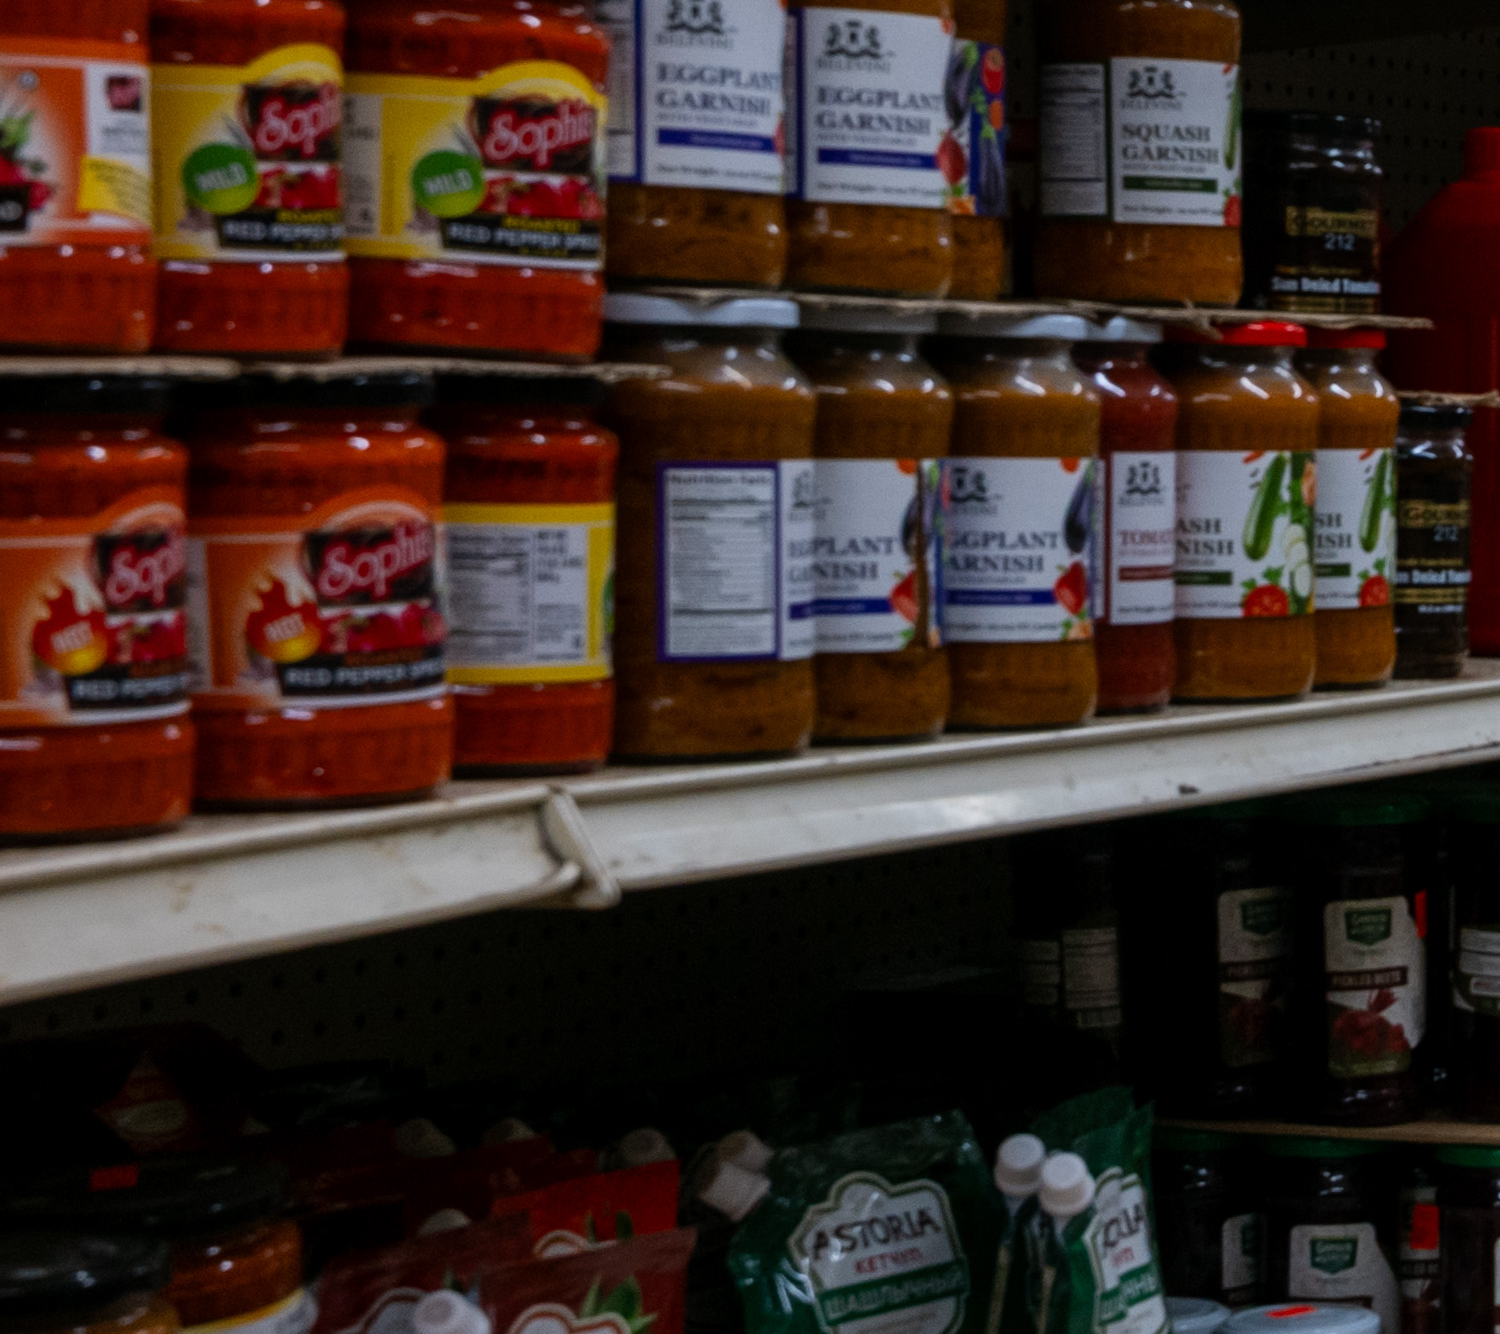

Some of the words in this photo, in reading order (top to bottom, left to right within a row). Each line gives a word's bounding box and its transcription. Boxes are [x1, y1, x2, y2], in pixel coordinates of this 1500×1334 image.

[655, 62, 783, 88] EGGPLANT
[655, 87, 772, 118] GARNISH
[816, 85, 942, 110] EGGPLANT
[816, 109, 933, 137] GARNISH
[1121, 120, 1211, 144] SQUASH
[1121, 141, 1221, 166] GARNISH
[1324, 231, 1355, 251] 212
[1434, 526, 1459, 544] 212
[811, 1207, 942, 1260] ASTORIA
